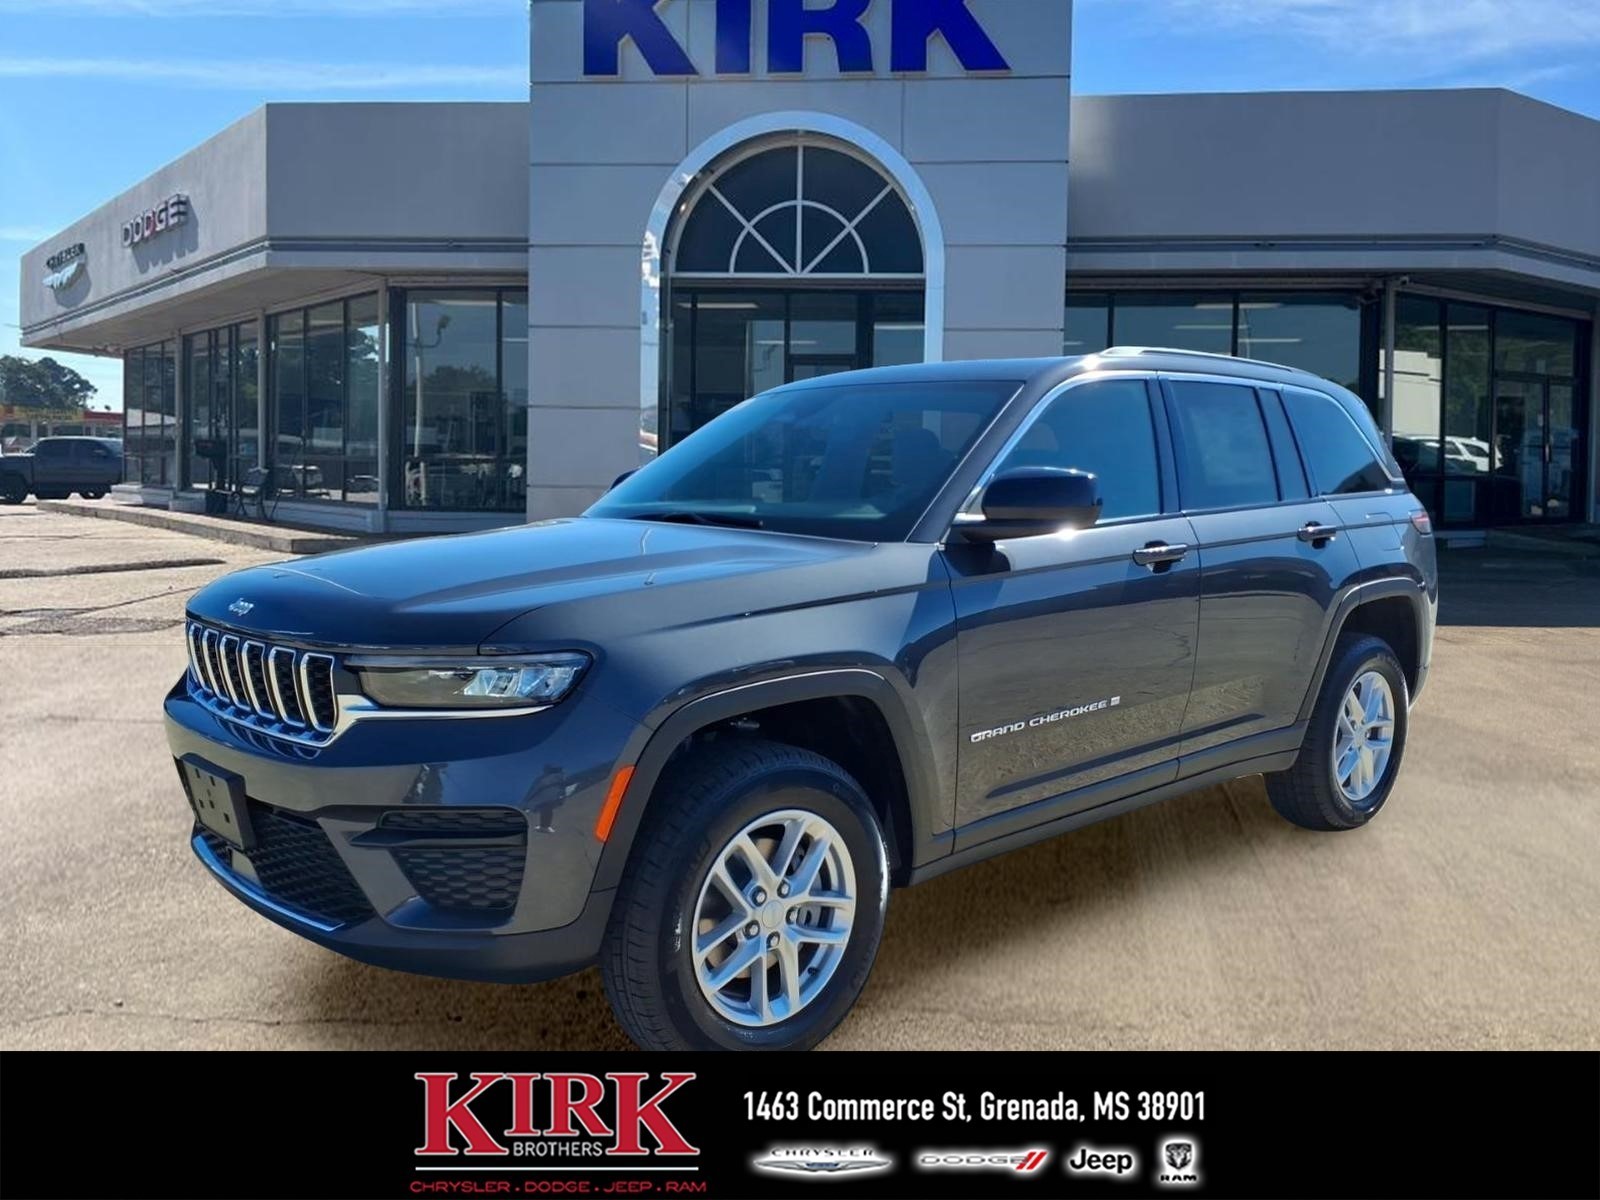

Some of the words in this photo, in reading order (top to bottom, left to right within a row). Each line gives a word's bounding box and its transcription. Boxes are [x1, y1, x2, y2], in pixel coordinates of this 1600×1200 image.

[583, 0, 1012, 76] KIRK
[121, 193, 188, 248] DODGE
[971, 722, 1025, 742] GRAND
[1029, 700, 1107, 727] CHEROKEE
